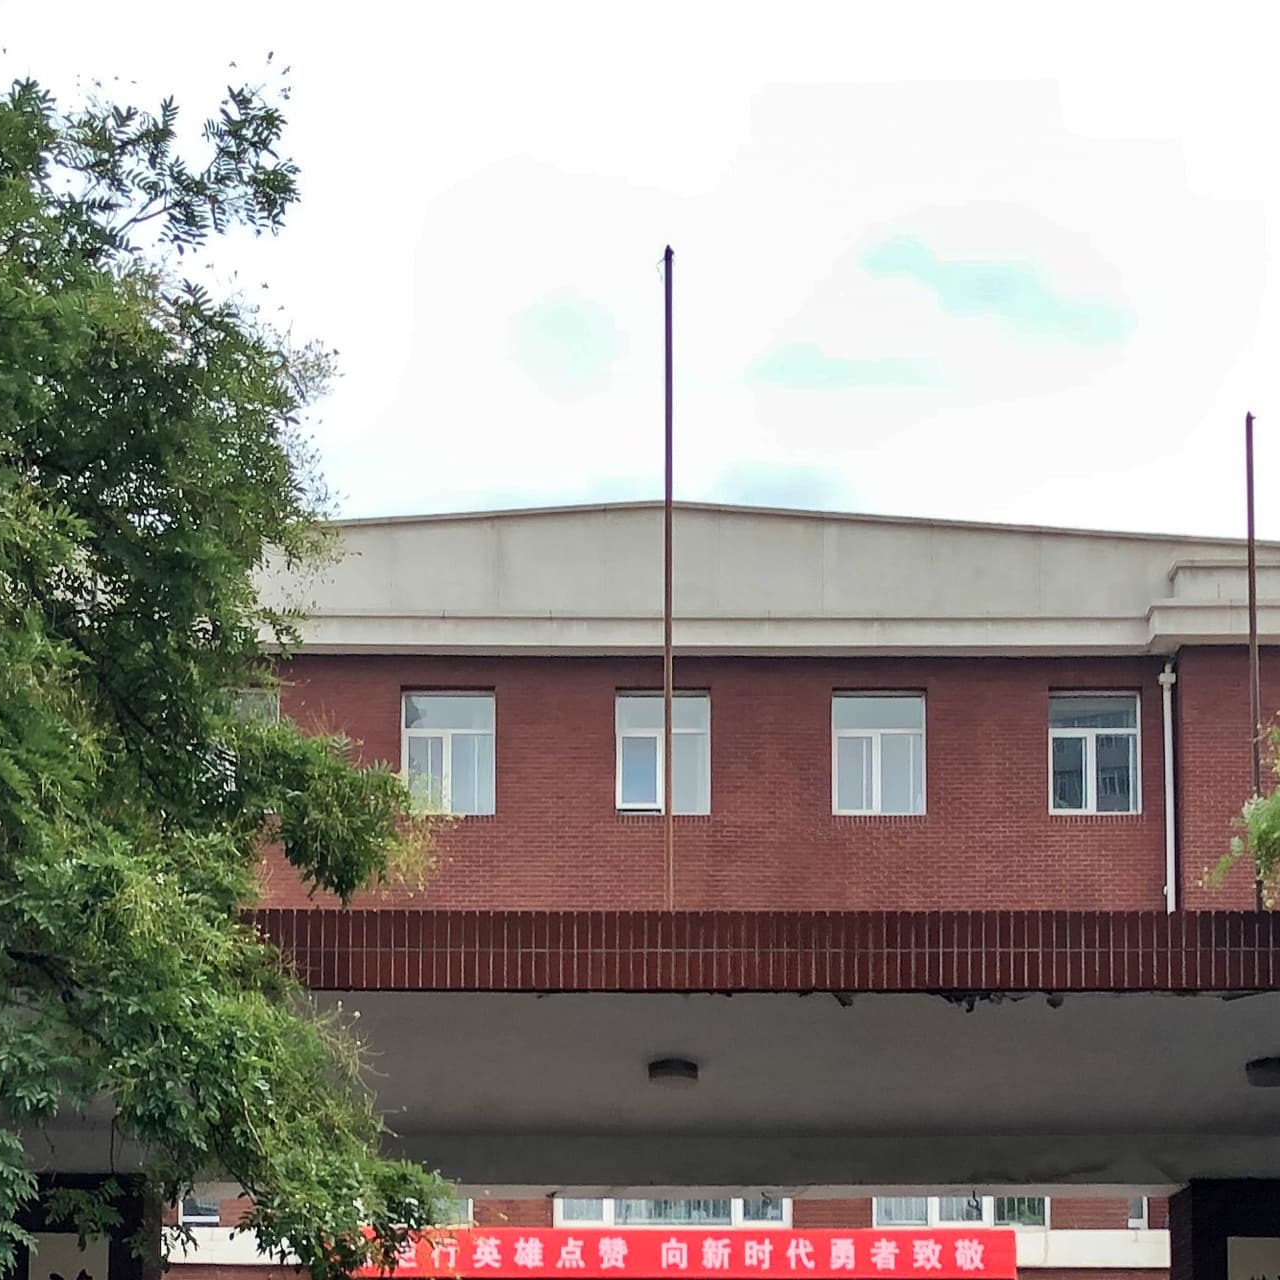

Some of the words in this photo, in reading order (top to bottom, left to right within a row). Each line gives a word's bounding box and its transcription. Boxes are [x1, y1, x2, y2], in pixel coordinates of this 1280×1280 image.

[660, 1237, 986, 1270] 向新时代勇者致敬
